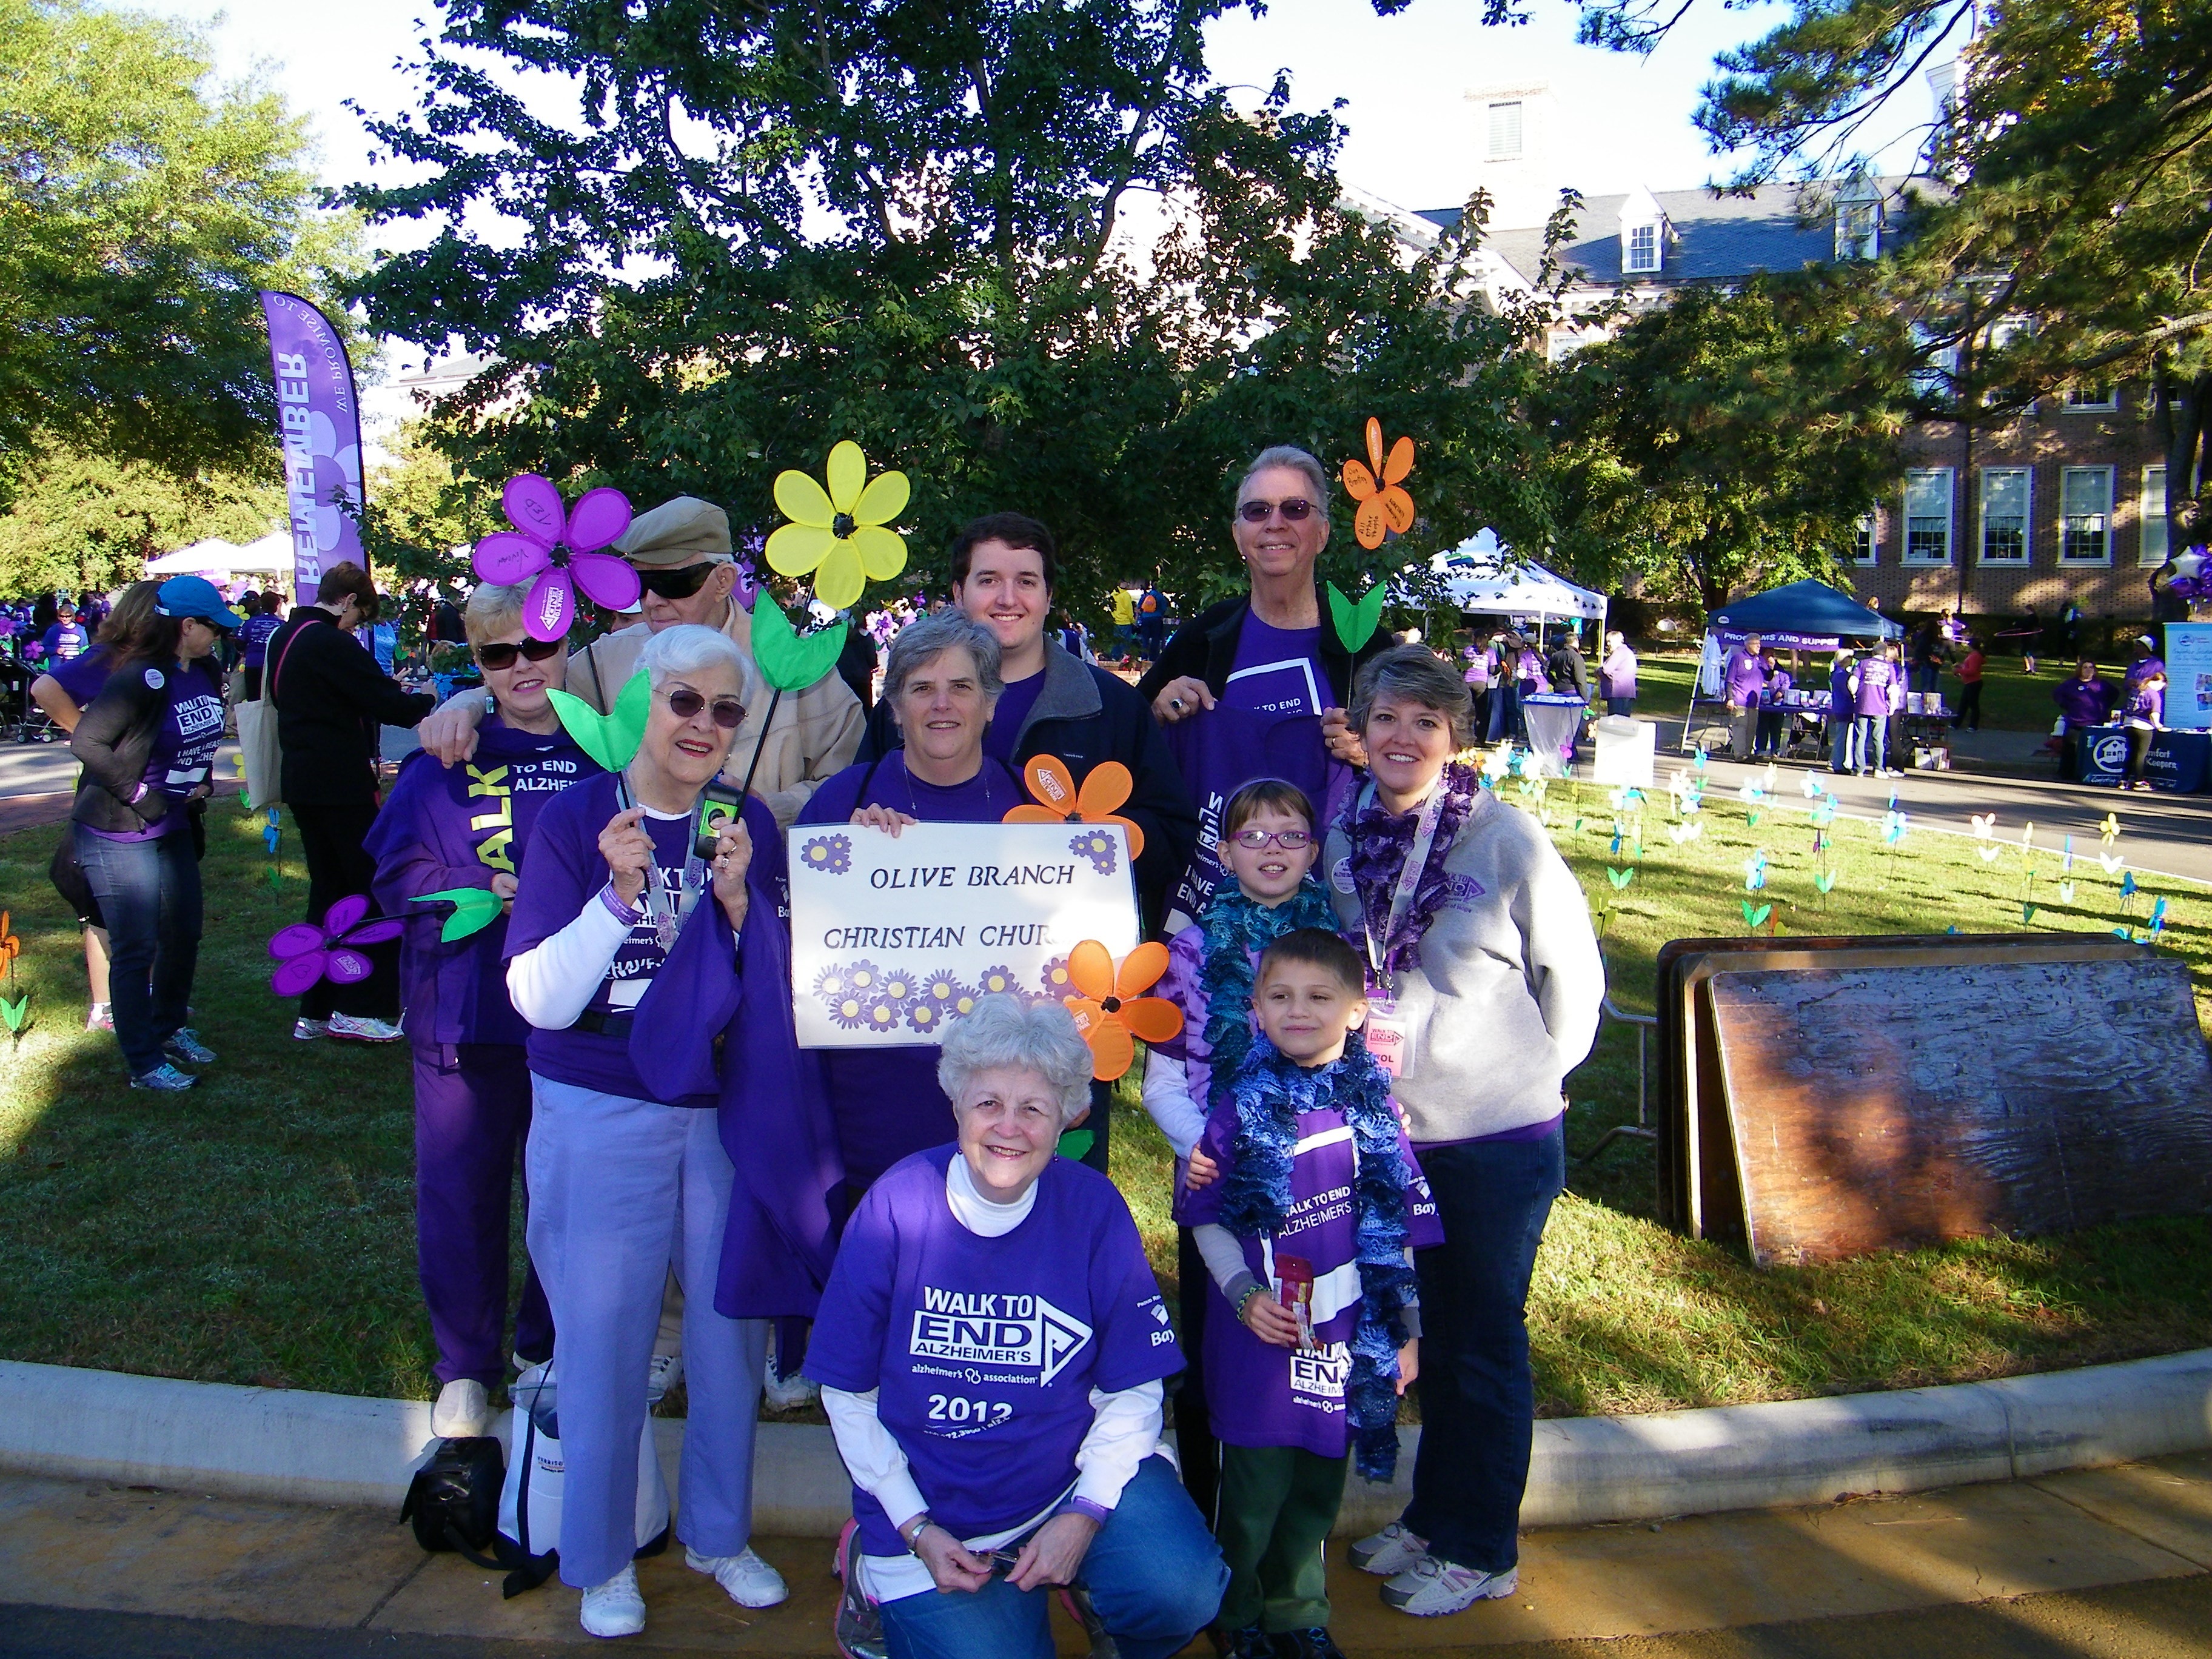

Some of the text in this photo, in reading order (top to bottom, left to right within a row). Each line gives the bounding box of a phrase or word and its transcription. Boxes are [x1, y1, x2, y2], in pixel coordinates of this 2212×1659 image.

[1777, 634, 1800, 643] AND
[1262, 697, 1301, 712] TO END
[181, 708, 212, 728] END
[182, 746, 201, 757] HAVE
[2148, 748, 2170, 759] mfort
[512, 760, 577, 774] TO END
[466, 763, 516, 874] ALK
[870, 865, 1075, 889] OLIVE BRANCH
[1185, 864, 1191, 877] I
[1445, 881, 1466, 891] ND
[778, 905, 789, 917] Ba
[623, 936, 654, 945] eimer's
[823, 924, 1056, 949] CHRISTIAN CHUR
[1285, 1186, 1351, 1218] ALK TO END
[1278, 1200, 1352, 1239] ALZHEIMER'S
[924, 1285, 1033, 1318] WALK TO
[918, 1315, 1032, 1348] END
[914, 1342, 1031, 1362] ALZHEIMER'S
[911, 1363, 1036, 1384] alzheimer's association
[1295, 1359, 1338, 1384] EN
[1294, 1379, 1342, 1394] ALZHEIM
[928, 1394, 1013, 1423] 2012
